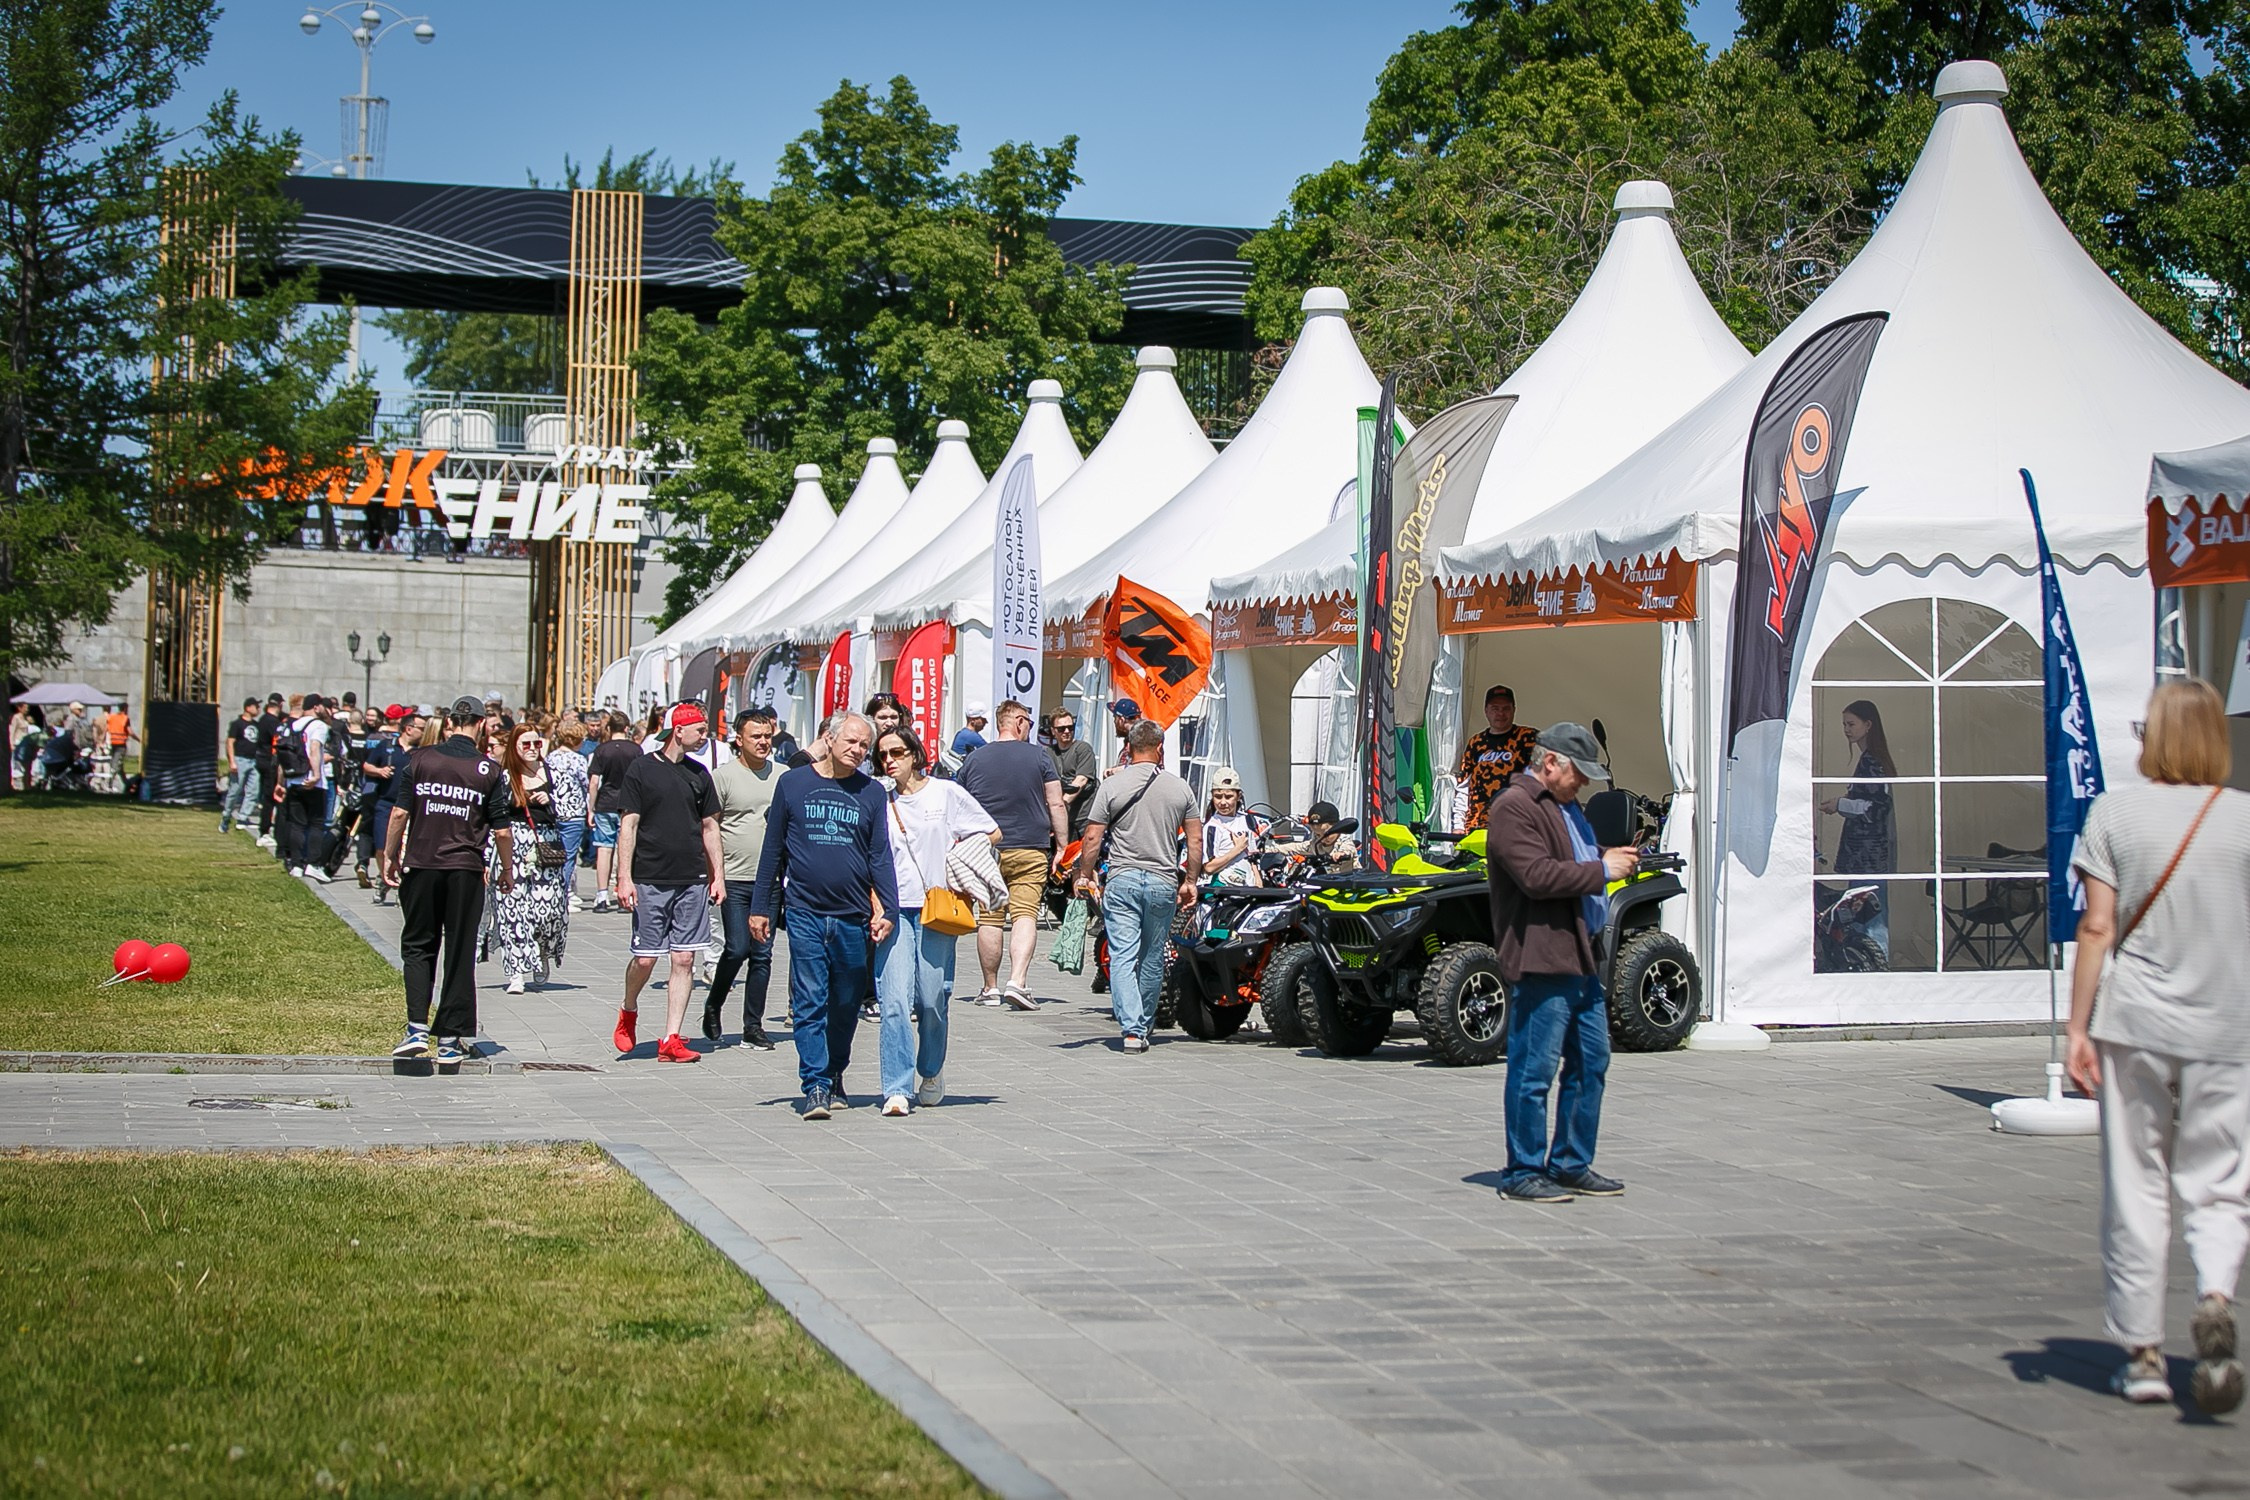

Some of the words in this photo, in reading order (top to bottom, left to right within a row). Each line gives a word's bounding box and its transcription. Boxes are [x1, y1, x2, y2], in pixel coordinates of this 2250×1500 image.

[1398, 454, 1446, 552] Moto
[2200, 513, 2250, 545] BAJ
[1014, 507, 1024, 636] УВЛЕЧЁННЫХ
[1027, 569, 1038, 640] ЛЮДЕЙ
[912, 657, 925, 743] OTOR
[928, 658, 938, 728] FORWARD
[1145, 676, 1171, 704] RACE
[478, 760, 490, 775] 6
[416, 782, 485, 805] SECURITY
[804, 804, 825, 819] TOM
[828, 805, 860, 826] TAILOR
